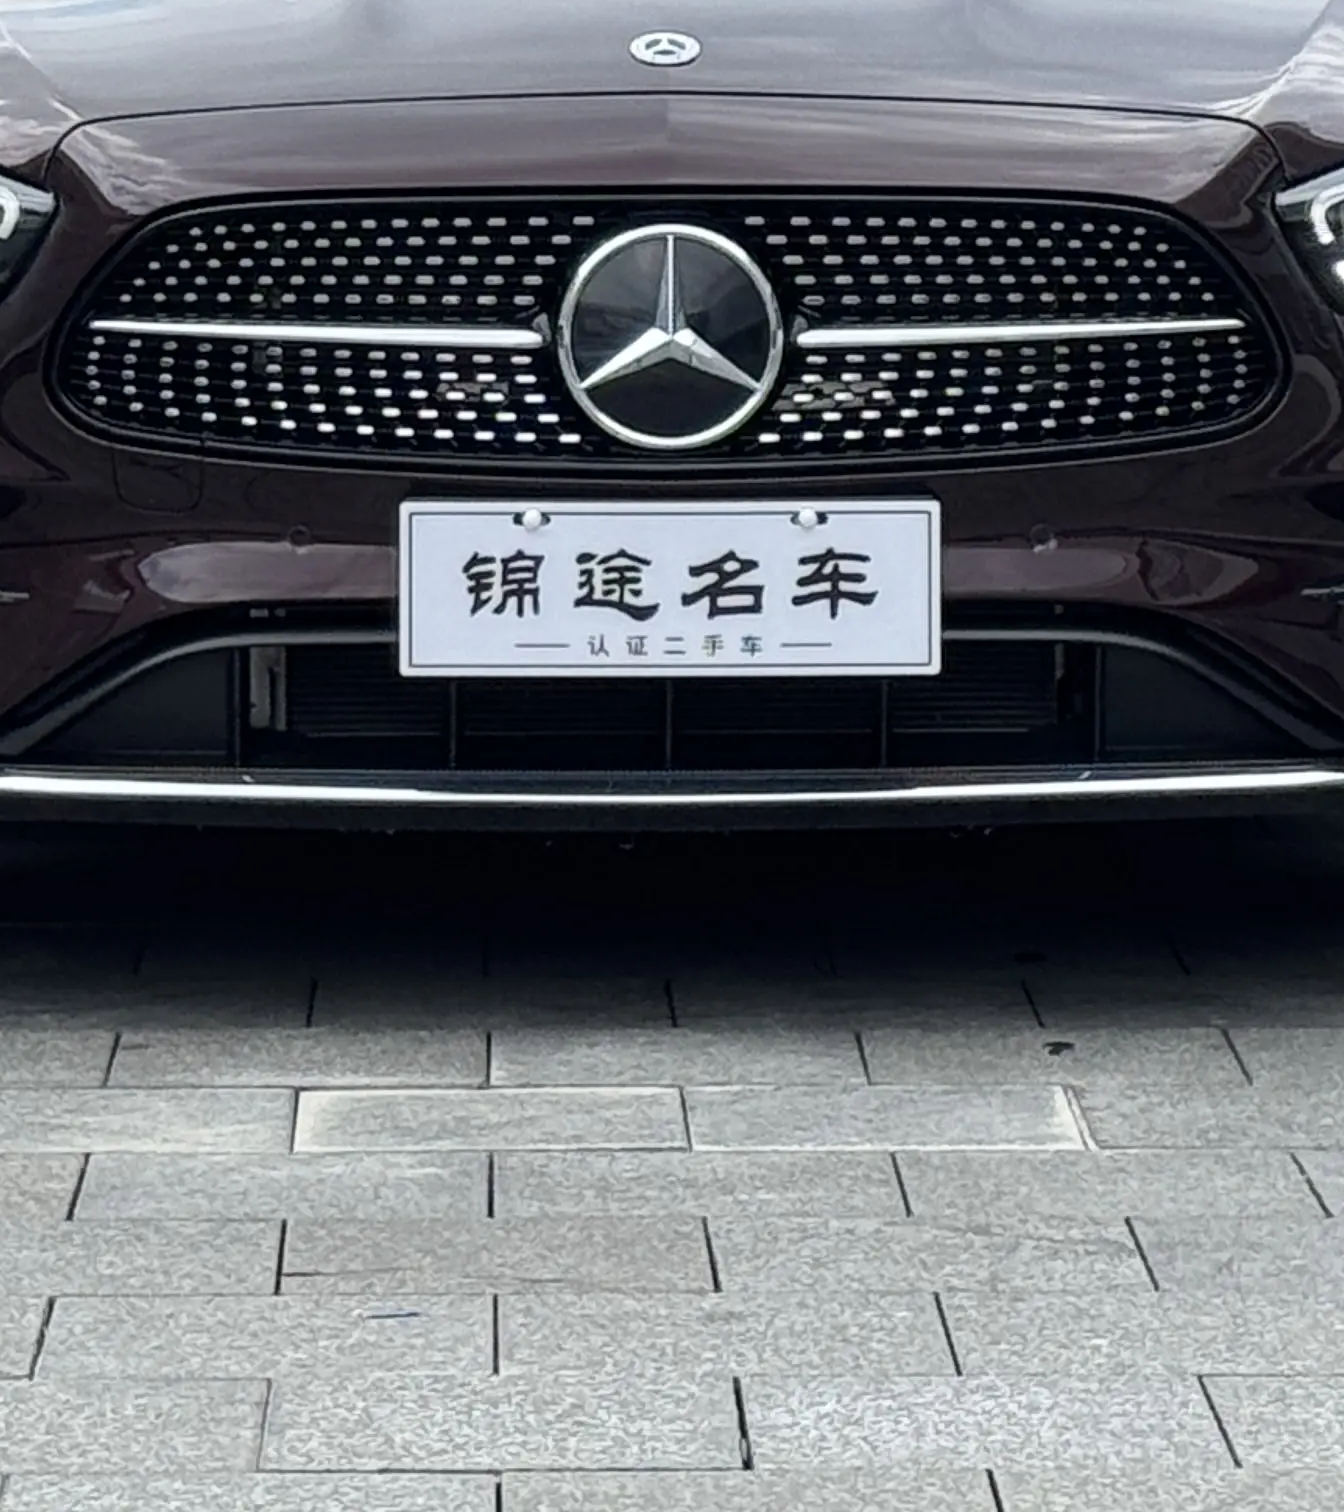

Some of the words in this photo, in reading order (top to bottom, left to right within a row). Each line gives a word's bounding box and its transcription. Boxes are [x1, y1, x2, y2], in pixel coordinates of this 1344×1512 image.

[462, 547, 879, 621] 锦途名车
[588, 634, 763, 658] 认证二手车
